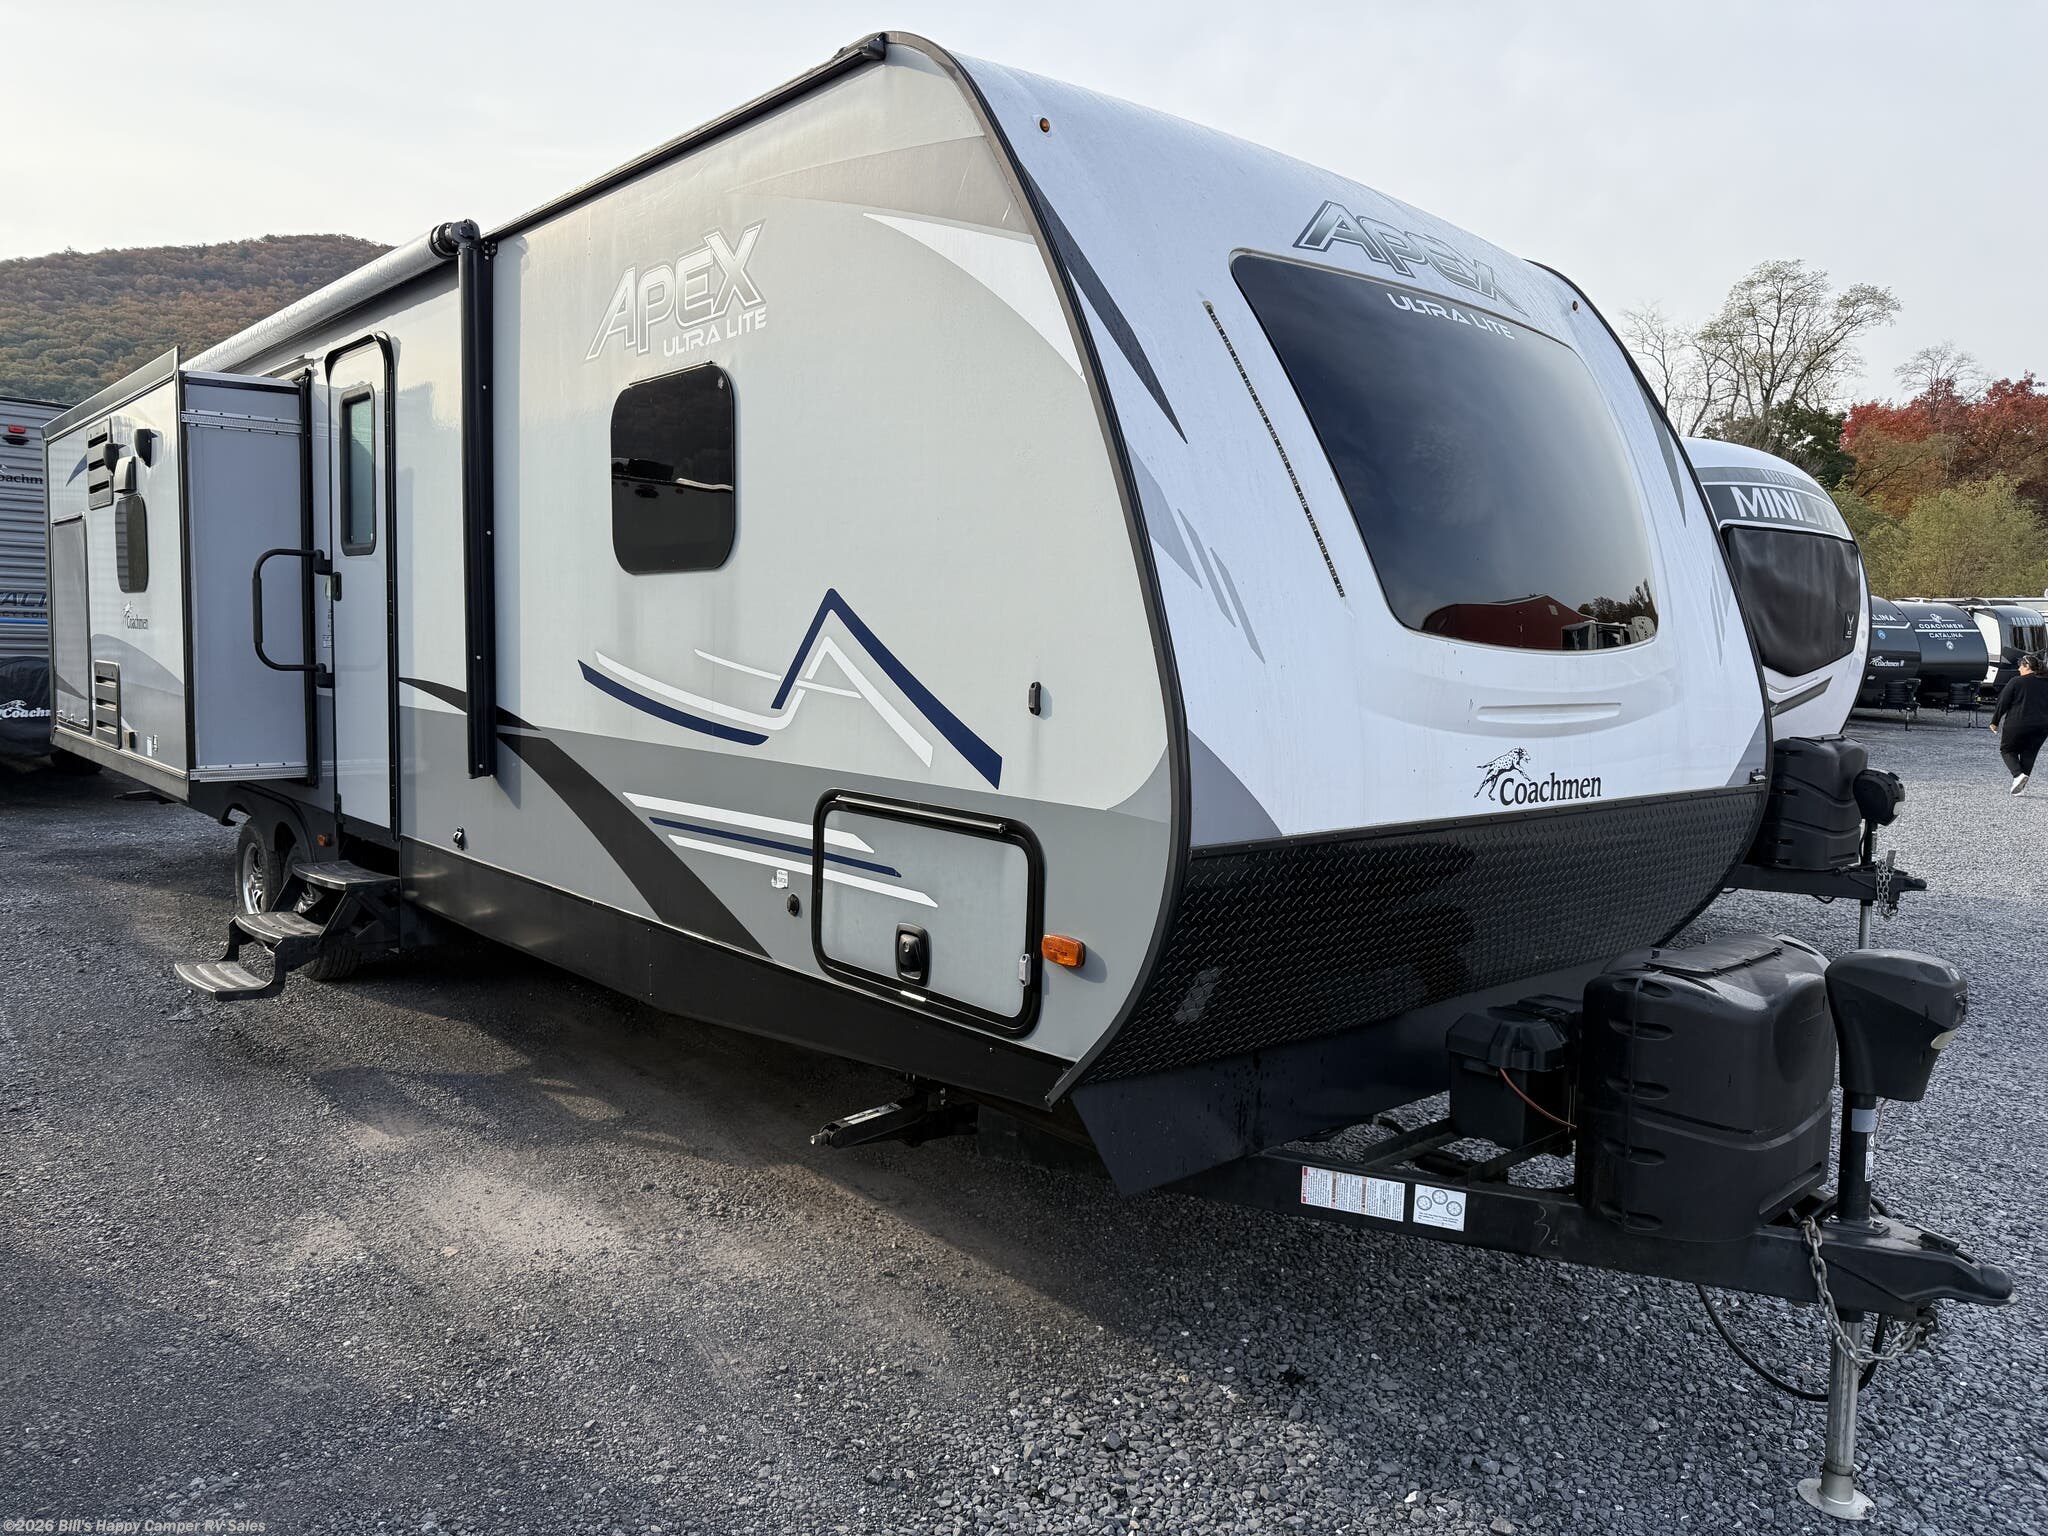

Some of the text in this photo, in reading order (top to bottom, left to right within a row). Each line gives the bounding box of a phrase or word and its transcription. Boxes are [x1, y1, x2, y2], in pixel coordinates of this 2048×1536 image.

[585, 219, 766, 361] APEX
[663, 306, 767, 358] ULTRA LITE
[1386, 293, 1515, 340] ULTRA LITE
[1500, 771, 1602, 806] Coachmen
